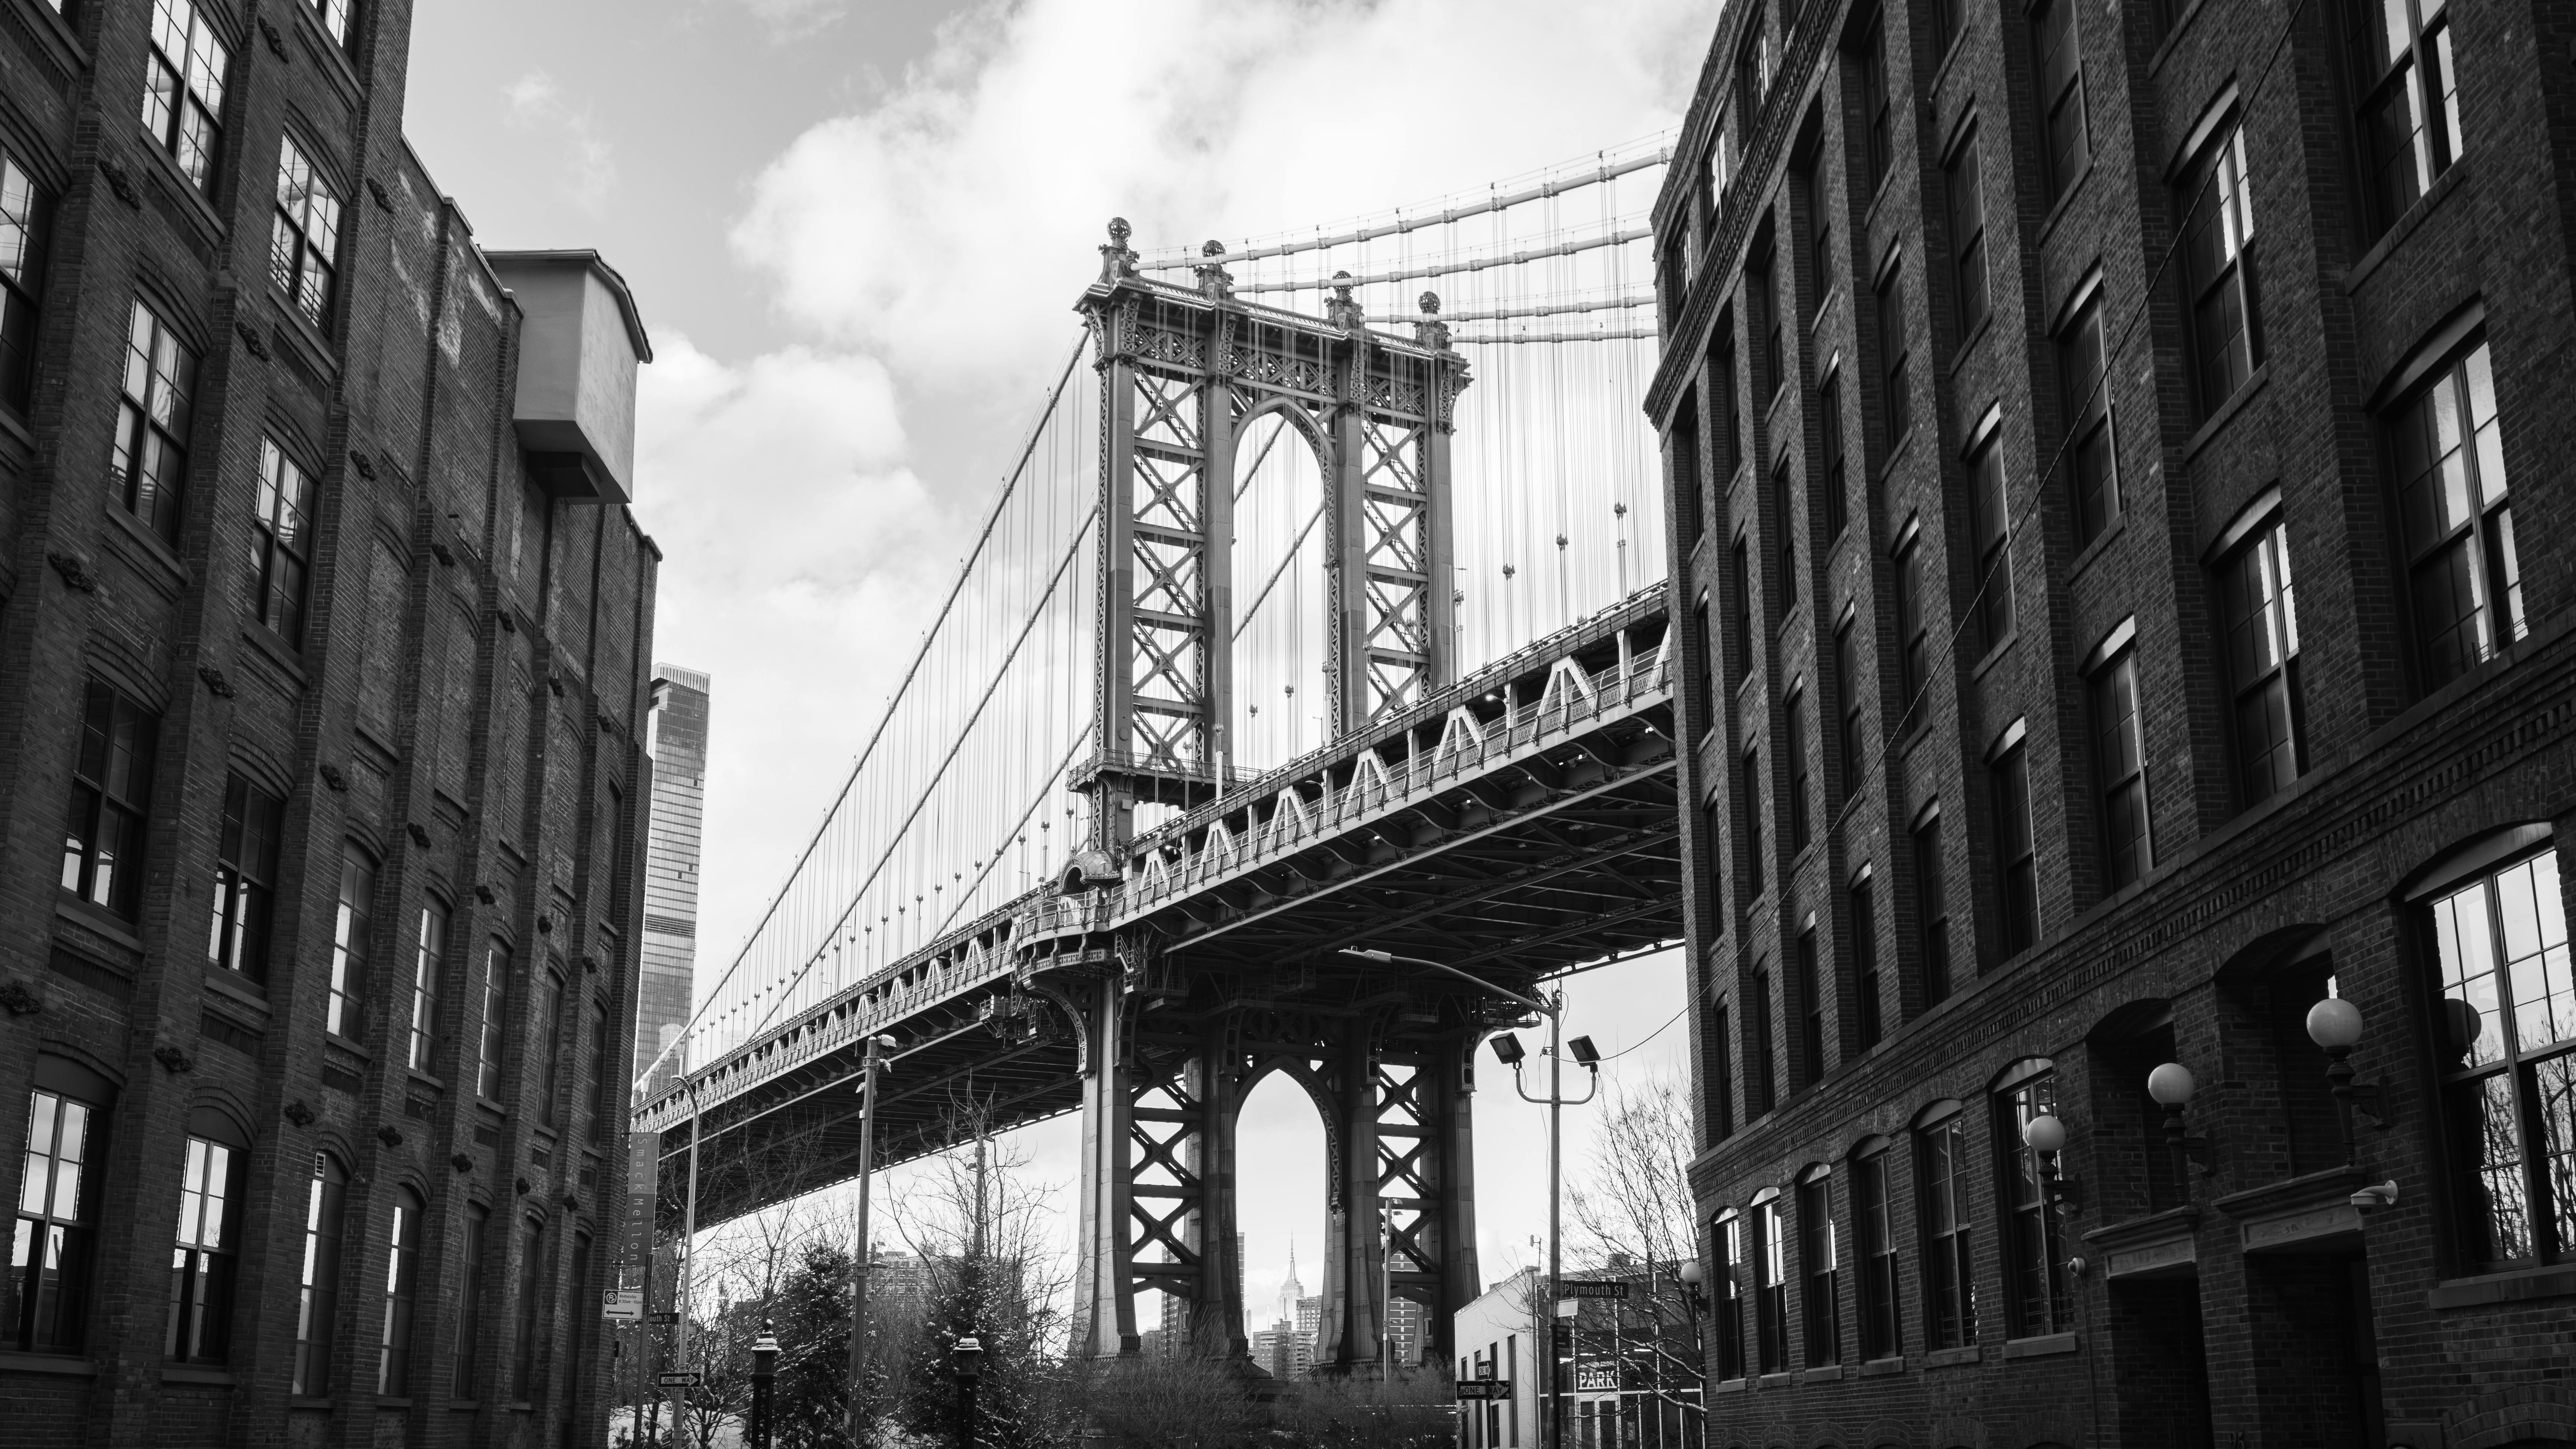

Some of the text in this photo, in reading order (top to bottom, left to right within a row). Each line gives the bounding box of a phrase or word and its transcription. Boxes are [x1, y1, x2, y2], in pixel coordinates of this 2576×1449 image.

[630, 1138, 647, 1261] Smack Mellon
[1564, 1284, 1623, 1297] Plymouth St
[1579, 1371, 1615, 1388] PARK
